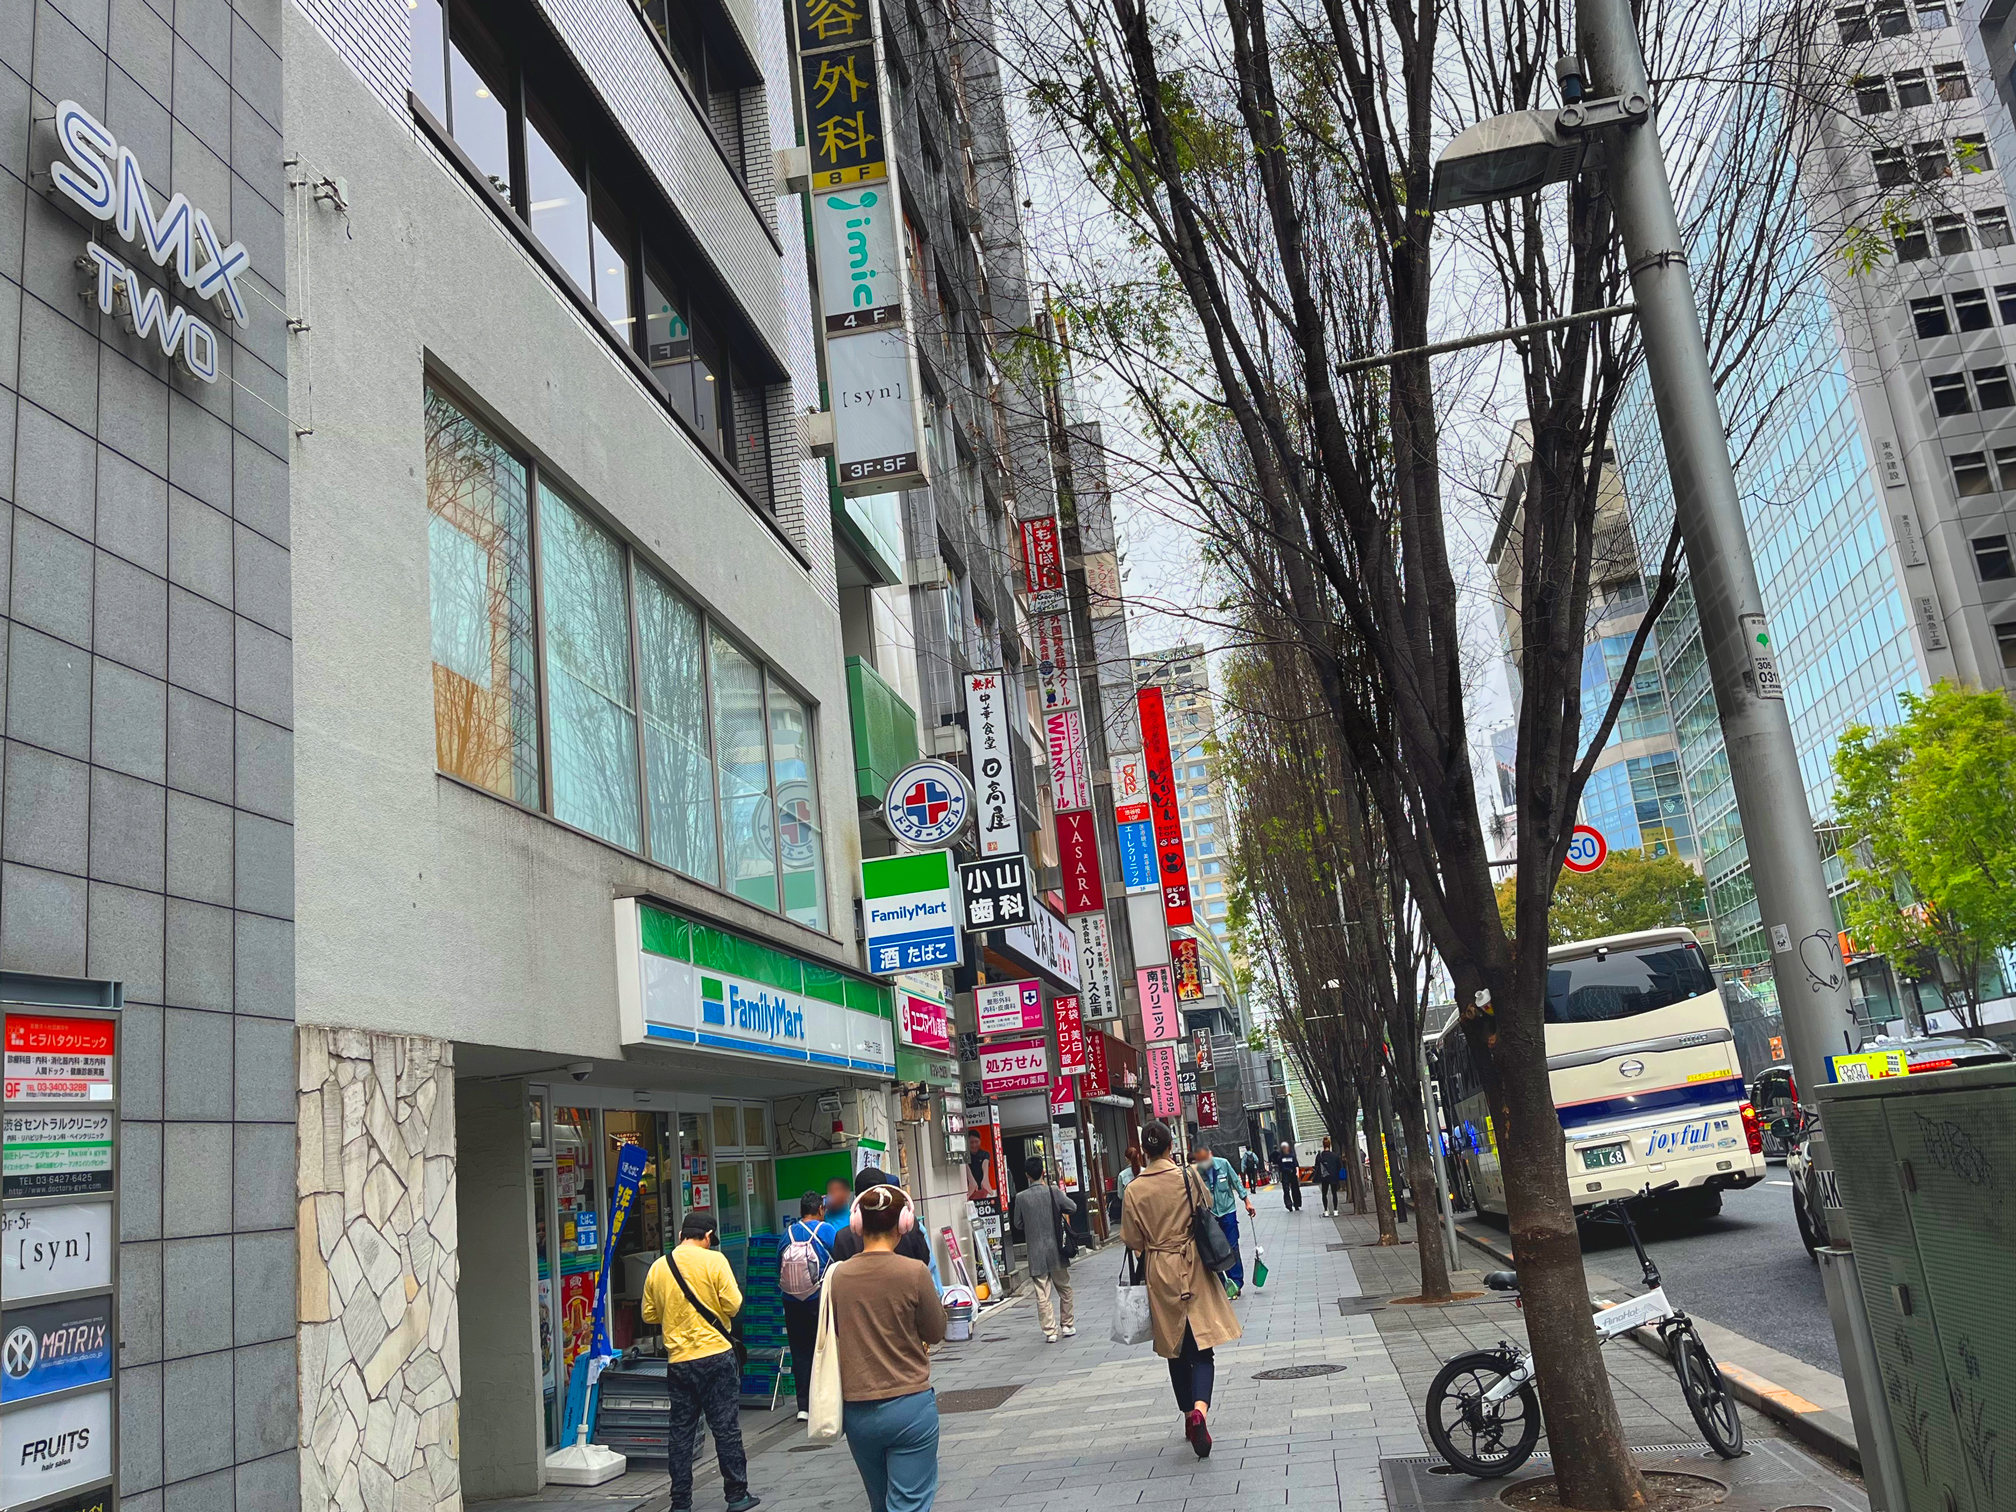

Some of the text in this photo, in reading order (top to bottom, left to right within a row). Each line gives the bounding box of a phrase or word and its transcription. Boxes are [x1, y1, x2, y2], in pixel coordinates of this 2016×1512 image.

[51, 99, 250, 330] SMX
[86, 241, 219, 384] TWO
[1881, 441, 1900, 480] 東急建設
[1901, 514, 1920, 563] 東急リニューアル
[1920, 598, 1942, 647] 世紀東急工業
[1757, 661, 1772, 670] 305
[979, 692, 997, 750] 中華食堂
[895, 809, 961, 839] ドクターズビル
[1068, 815, 1092, 908] VASARA
[1124, 826, 1140, 885] エーレクリニック
[1569, 837, 1596, 861] 50
[967, 863, 1022, 894] 小山
[871, 901, 947, 923] FamilyMart
[968, 893, 1025, 925] 歯科
[1167, 893, 1186, 908] 3F
[1081, 917, 1091, 945] 株式会社
[880, 942, 948, 970] 酒 たばこ
[728, 983, 805, 1040] FamilyMart
[1146, 970, 1165, 1038] 南クリニック
[29, 1032, 108, 1049] ヒラハタクリニック
[1056, 1000, 1072, 1065] ヒアルロン酸
[1066, 997, 1083, 1052] 涙袋・美白
[986, 1054, 1043, 1075] 処方せん
[1085, 1035, 1099, 1089] VASARA
[5, 1082, 21, 1099] 9F
[37, 1082, 88, 1092] 03-3400-3288
[986, 1074, 1047, 1091] ユニスマイル薬局
[1160, 1049, 1176, 1113] 03(5468)7595
[4, 1117, 108, 1131] 渋谷セントラルクリニック
[1645, 1122, 1711, 1157] joyful
[19, 1176, 34, 1186] TEL
[41, 1324, 106, 1360] MATRIX
[21, 1428, 90, 1466] FRUITS
[41, 1458, 71, 1472] hair salon
